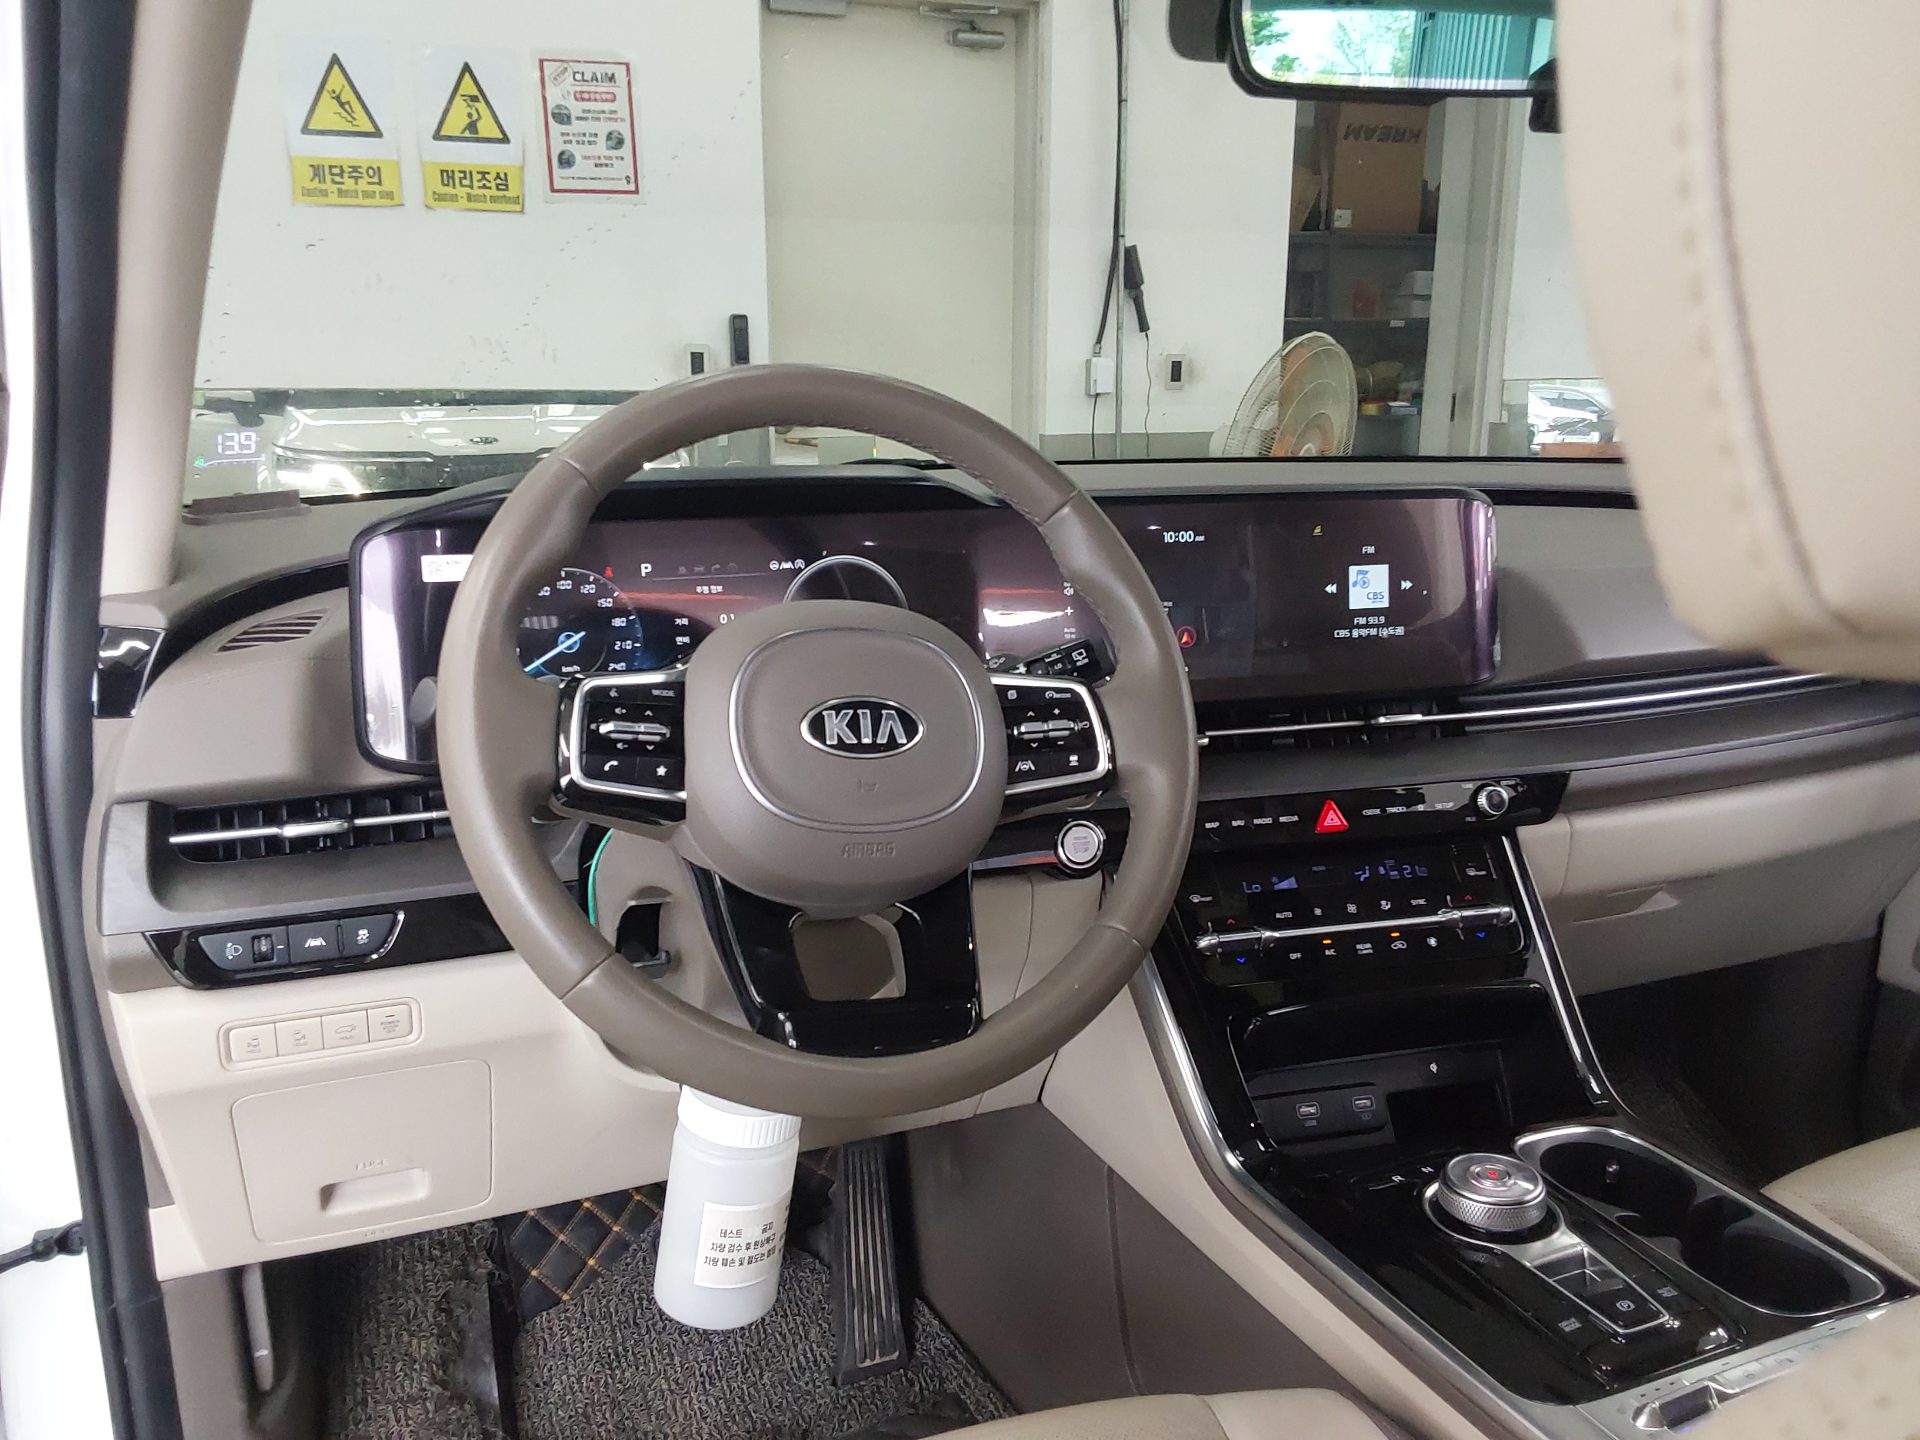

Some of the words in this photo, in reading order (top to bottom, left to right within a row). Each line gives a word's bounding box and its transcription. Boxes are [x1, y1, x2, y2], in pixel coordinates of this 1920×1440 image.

[572, 71, 617, 84] CLAIM
[308, 164, 383, 186] 계단주의
[440, 169, 509, 192] 머리조심
[301, 186, 329, 198] Caution
[432, 190, 459, 202] Caution
[1162, 530, 1194, 543] 10:00
[1362, 545, 1375, 554] FM
[640, 563, 652, 577] P
[556, 580, 572, 590] 100
[580, 584, 596, 594] 120
[1366, 591, 1384, 600] CBS
[597, 598, 613, 608] 150
[611, 617, 627, 627] 180
[1353, 616, 1366, 626] FM
[1367, 616, 1385, 625] 93.9
[1334, 629, 1350, 638] CBS
[614, 640, 632, 650] 210
[822, 708, 908, 745] KIA
[841, 842, 896, 858] AIRBAG
[1275, 911, 1293, 919] AUTO
[1289, 952, 1302, 960] OFF
[1391, 1174, 1406, 1183] R
[719, 1228, 743, 1239] 테스트
[761, 1221, 774, 1235] 금지
[710, 1242, 726, 1253] 차량
[727, 1243, 743, 1254] 검수
[744, 1241, 752, 1251] 후
[703, 1255, 720, 1267] 차량
